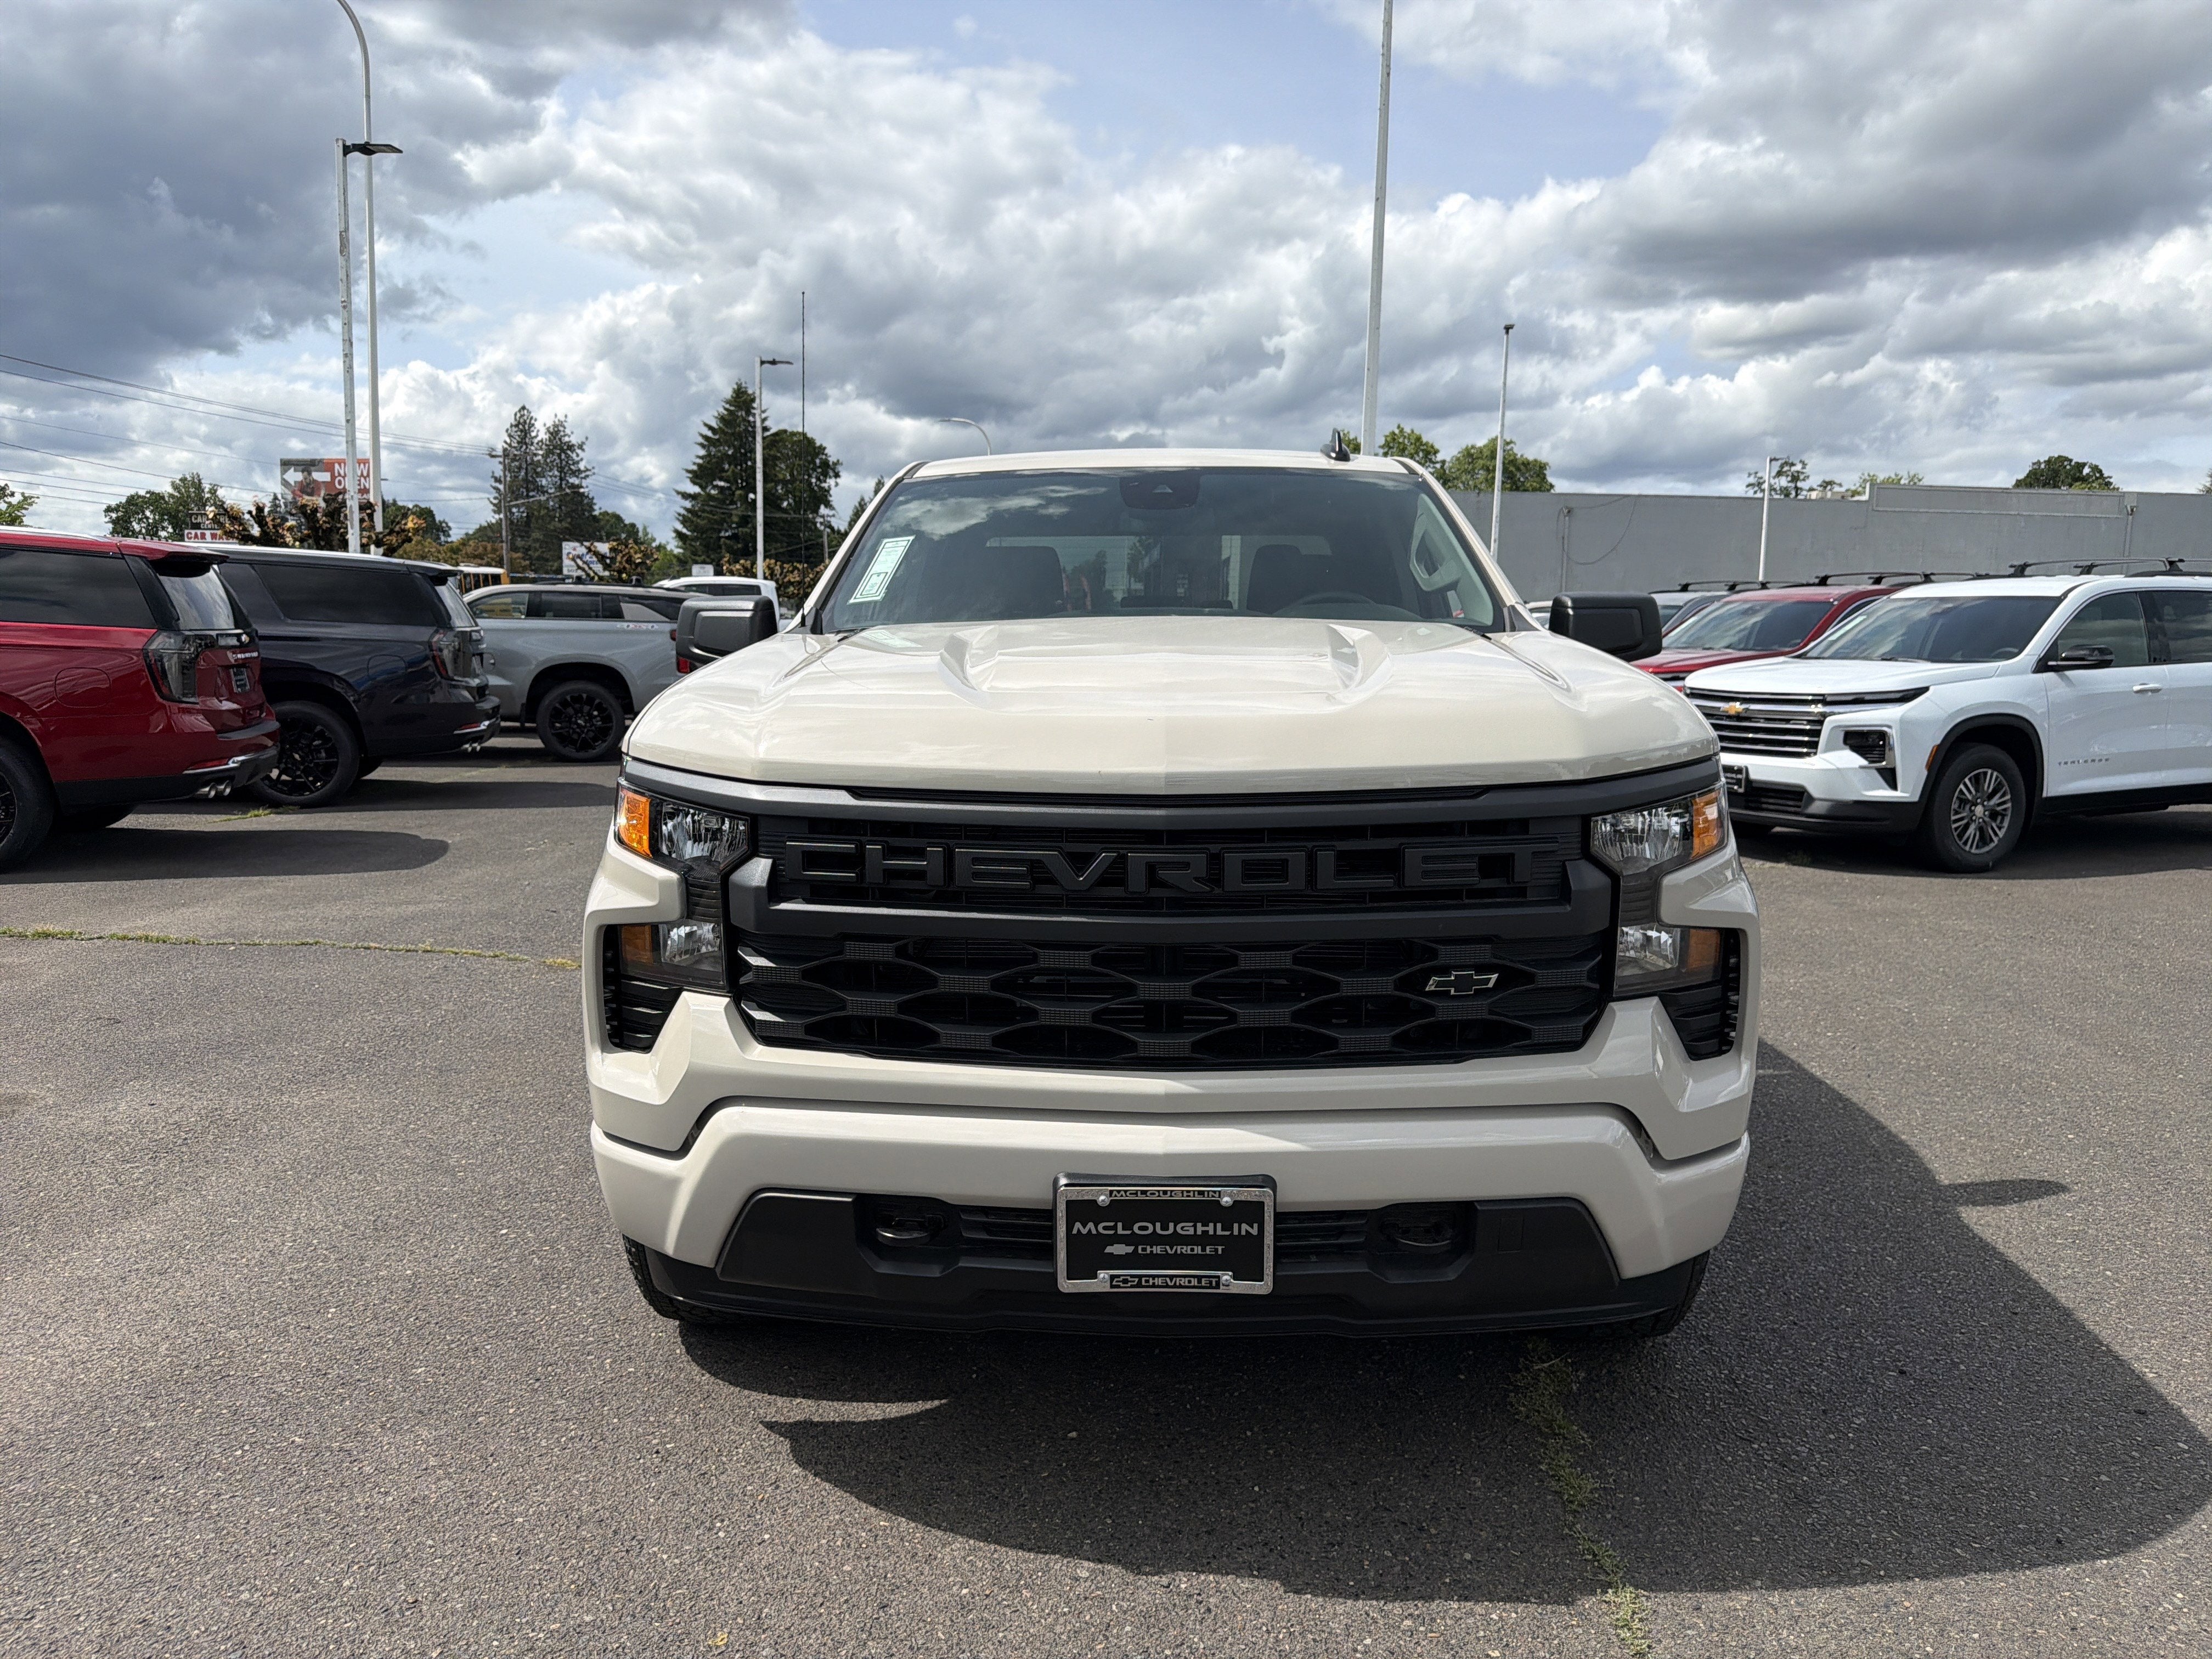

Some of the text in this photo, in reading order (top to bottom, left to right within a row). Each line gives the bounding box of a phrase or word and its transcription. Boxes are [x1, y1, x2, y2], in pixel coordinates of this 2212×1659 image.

[335, 462, 369, 477] NW
[335, 477, 369, 489] ON
[187, 532, 238, 541] CAR WA
[785, 839, 1558, 893] CHEVROLET
[1111, 1190, 1220, 1198] MCLOUGHLIN
[1071, 1222, 1259, 1236] MCLOUGHLIN
[1138, 1245, 1226, 1255] CHEVROLET
[1141, 1277, 1219, 1287] CHEVROLET
